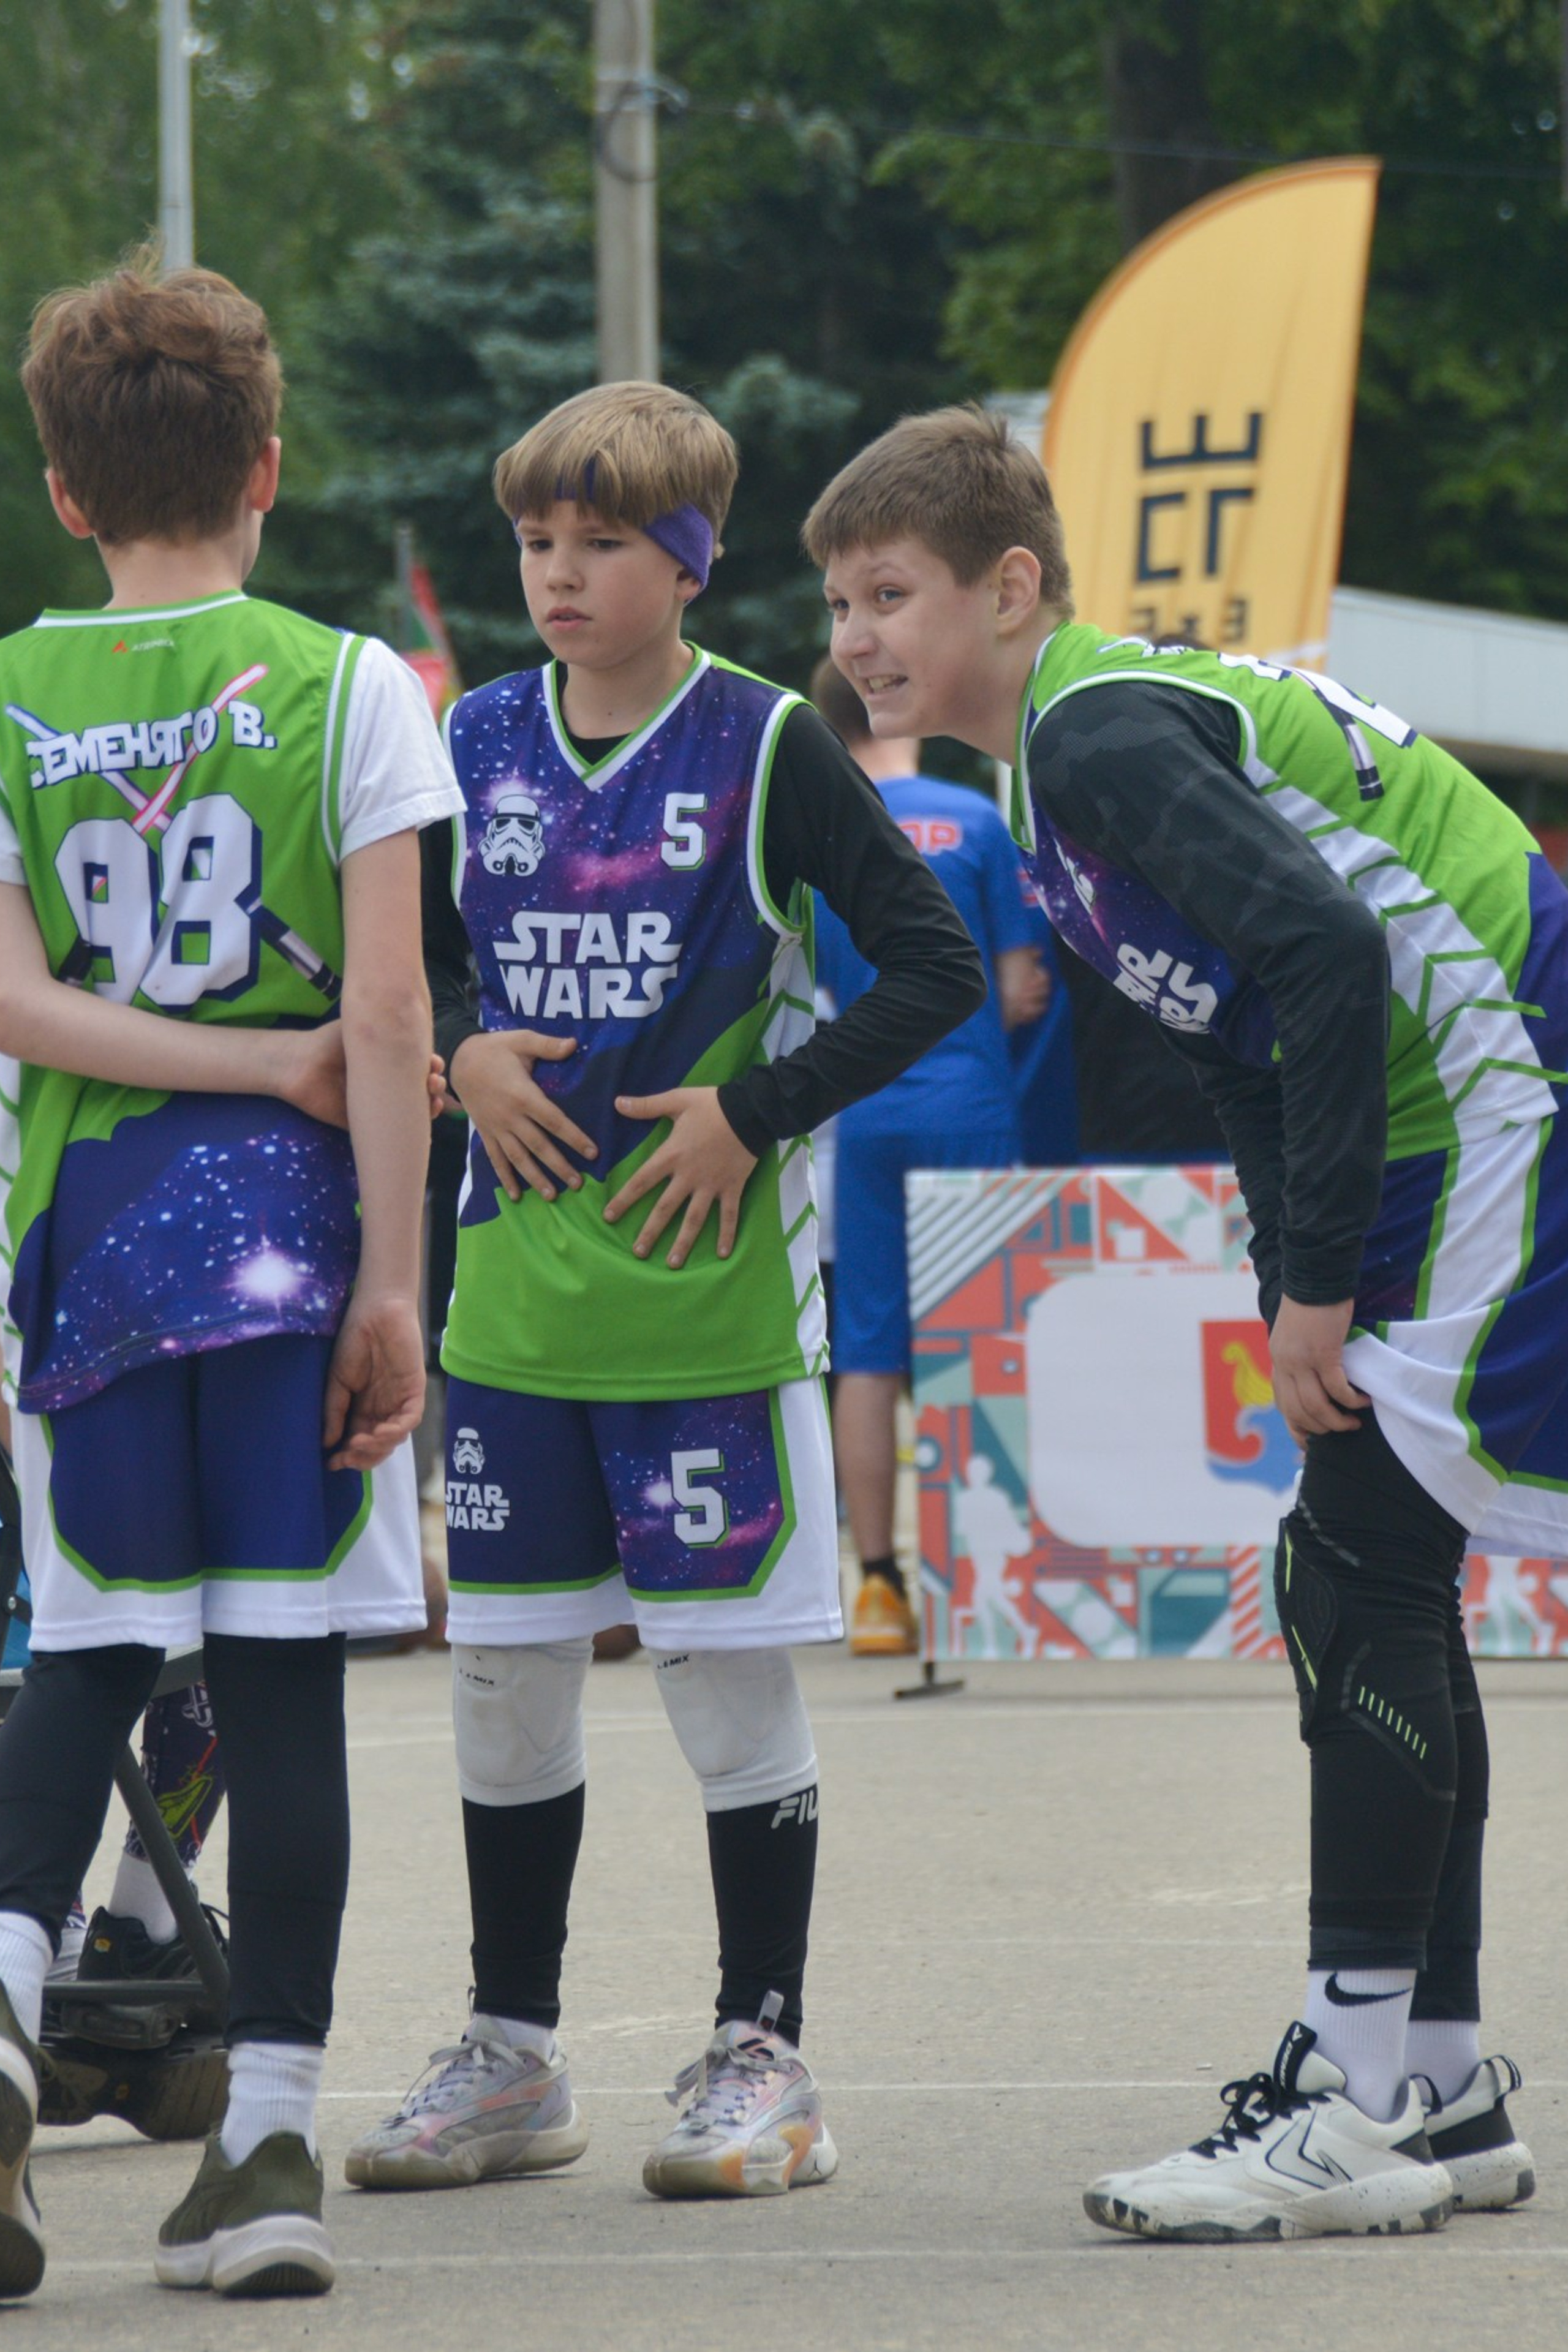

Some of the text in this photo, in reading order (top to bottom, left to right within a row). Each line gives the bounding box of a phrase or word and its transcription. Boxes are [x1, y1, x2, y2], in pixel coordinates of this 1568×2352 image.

[661, 793, 707, 870] 5
[55, 794, 262, 1014] 98
[493, 911, 683, 964] STAR
[499, 963, 678, 1019] WARS
[671, 1448, 729, 1549] 5
[771, 1789, 818, 1830] FIL
